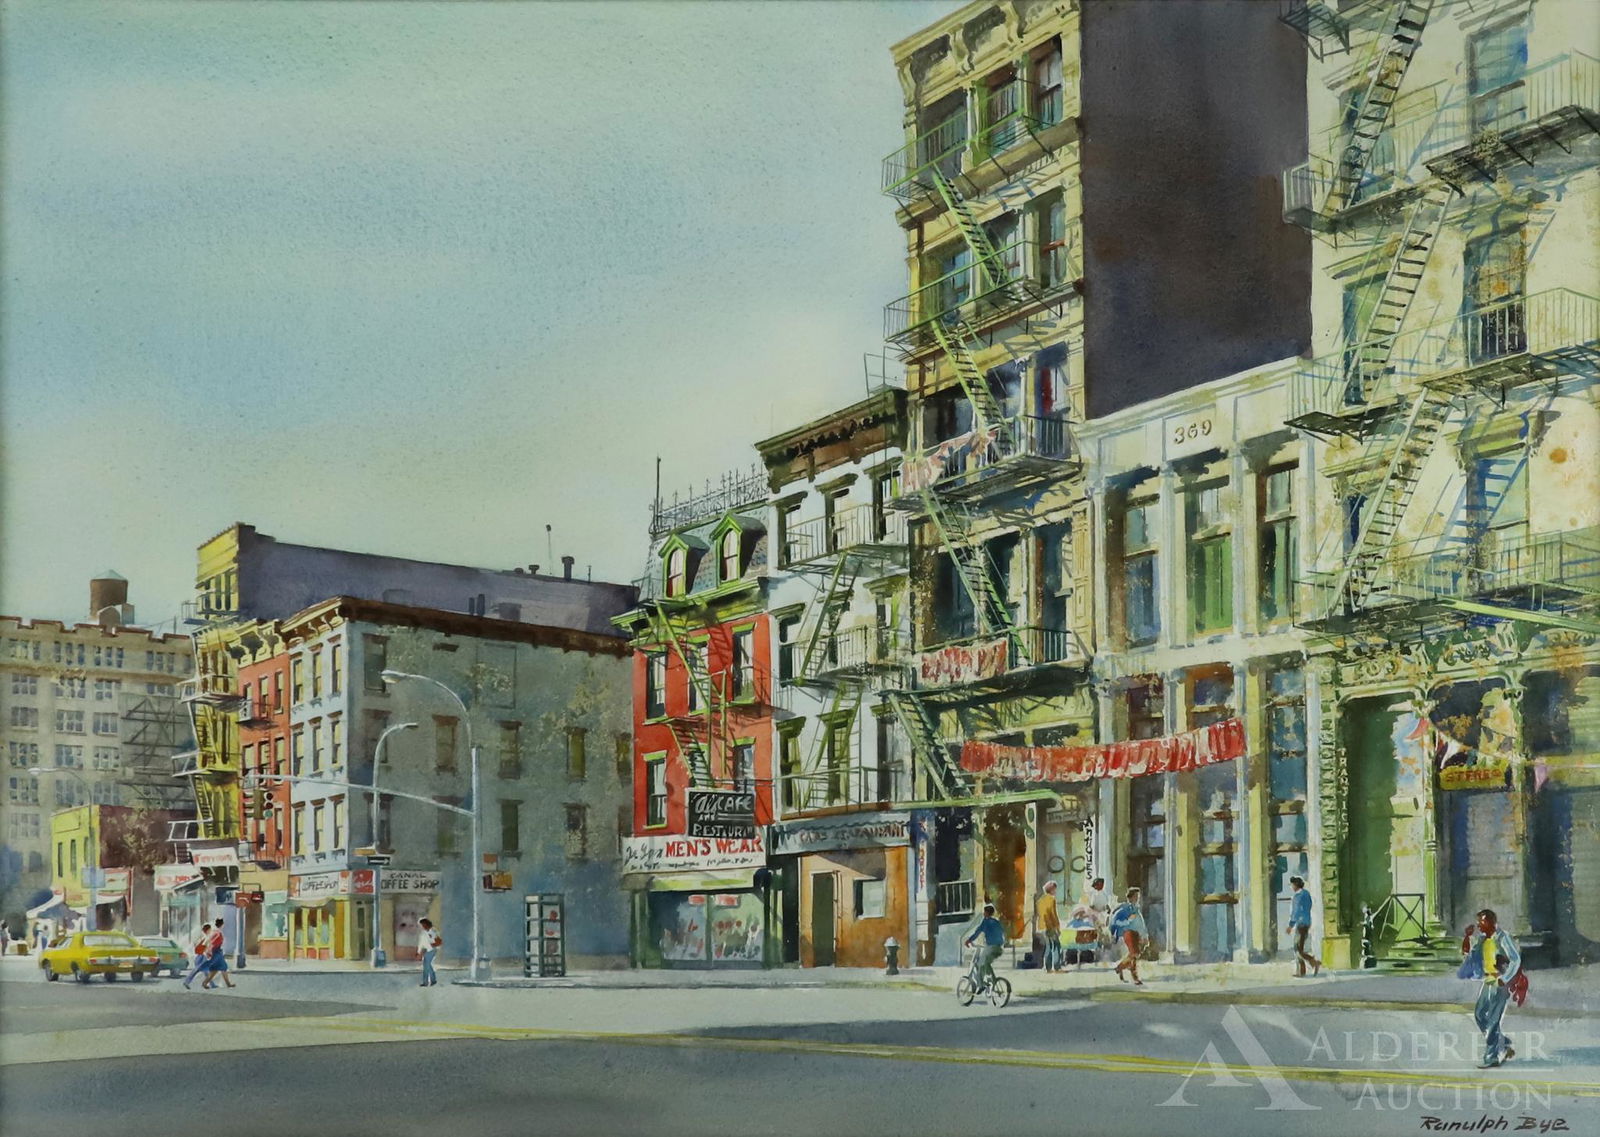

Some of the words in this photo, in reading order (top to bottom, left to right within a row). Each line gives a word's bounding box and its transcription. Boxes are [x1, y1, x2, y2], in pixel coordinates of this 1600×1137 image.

[1174, 419, 1212, 444] 369
[665, 838, 711, 857] MEN'S
[715, 835, 764, 854] WEAR
[413, 879, 440, 889] SHOP
[1513, 1116, 1571, 1134] Bye
